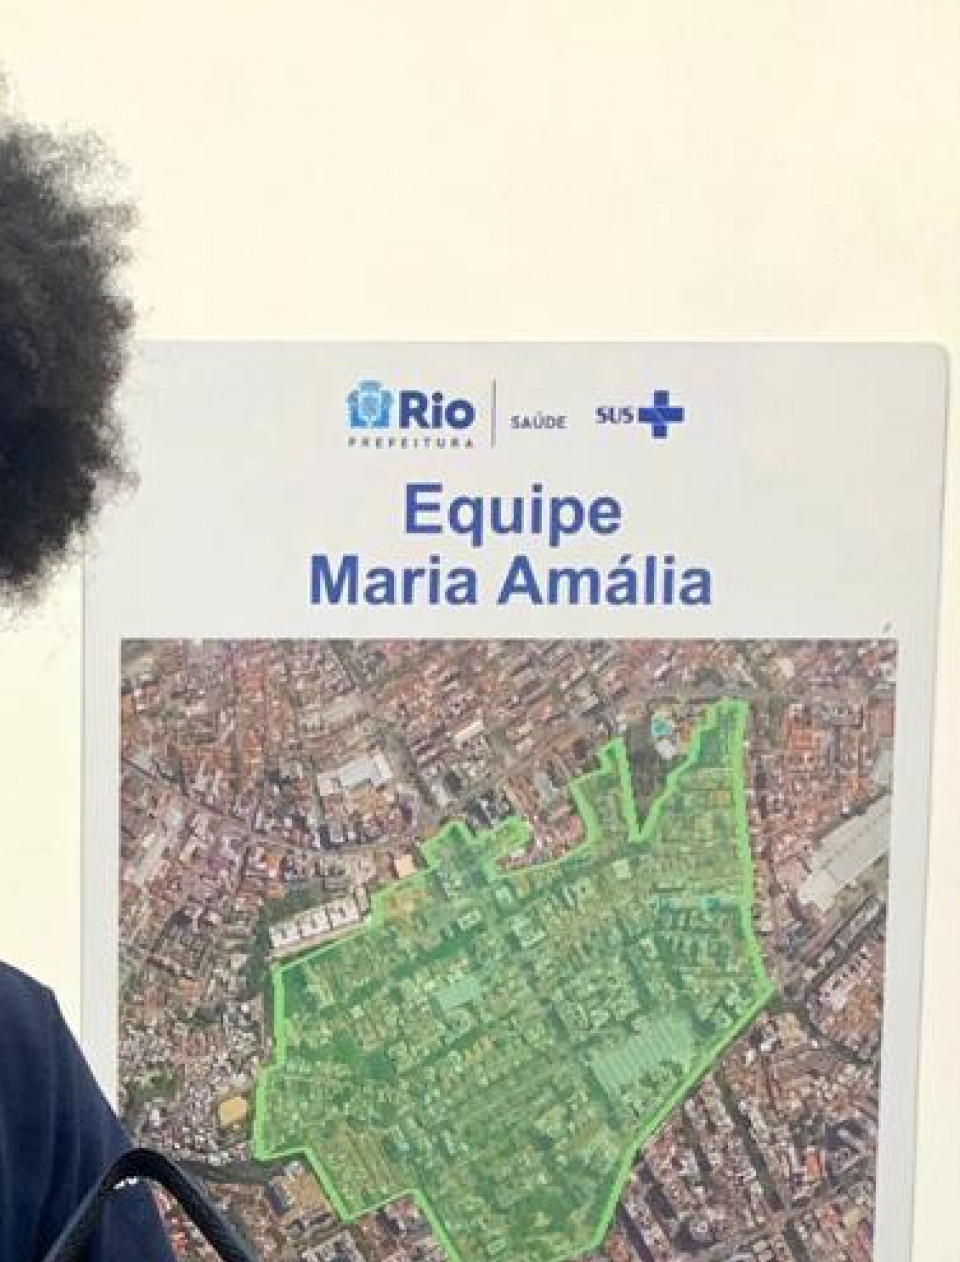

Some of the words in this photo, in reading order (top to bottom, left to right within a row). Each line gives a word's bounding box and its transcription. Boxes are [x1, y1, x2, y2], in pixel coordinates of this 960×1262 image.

[398, 390, 476, 430] Rio
[510, 411, 568, 430] SAÚDE
[595, 406, 635, 424] SUS
[347, 437, 475, 449] PREFEITURA
[405, 482, 622, 547] Equipe
[310, 554, 477, 606] Maria
[498, 554, 712, 606] Amália
